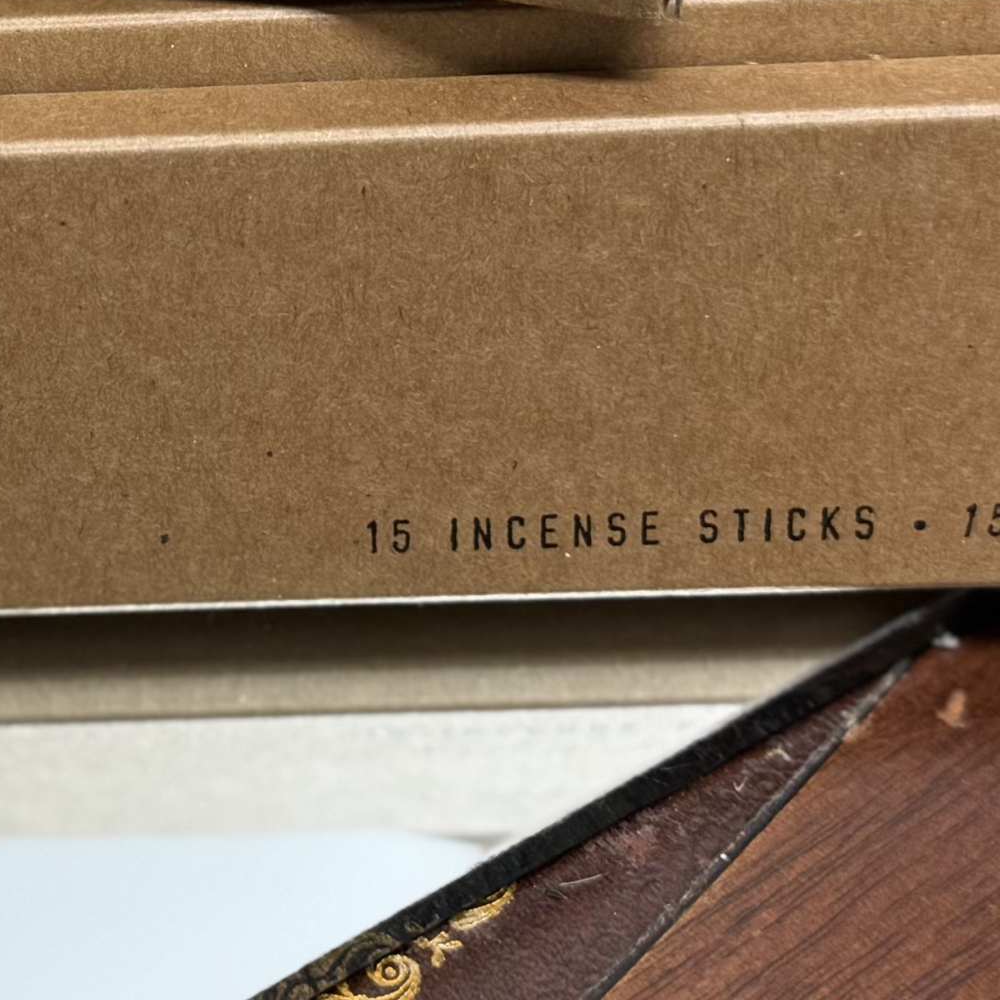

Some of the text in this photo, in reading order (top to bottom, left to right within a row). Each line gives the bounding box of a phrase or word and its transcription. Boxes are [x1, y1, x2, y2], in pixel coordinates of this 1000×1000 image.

[366, 518, 411, 555] 15
[449, 510, 661, 553] INCENSE
[698, 504, 876, 545] STICKS
